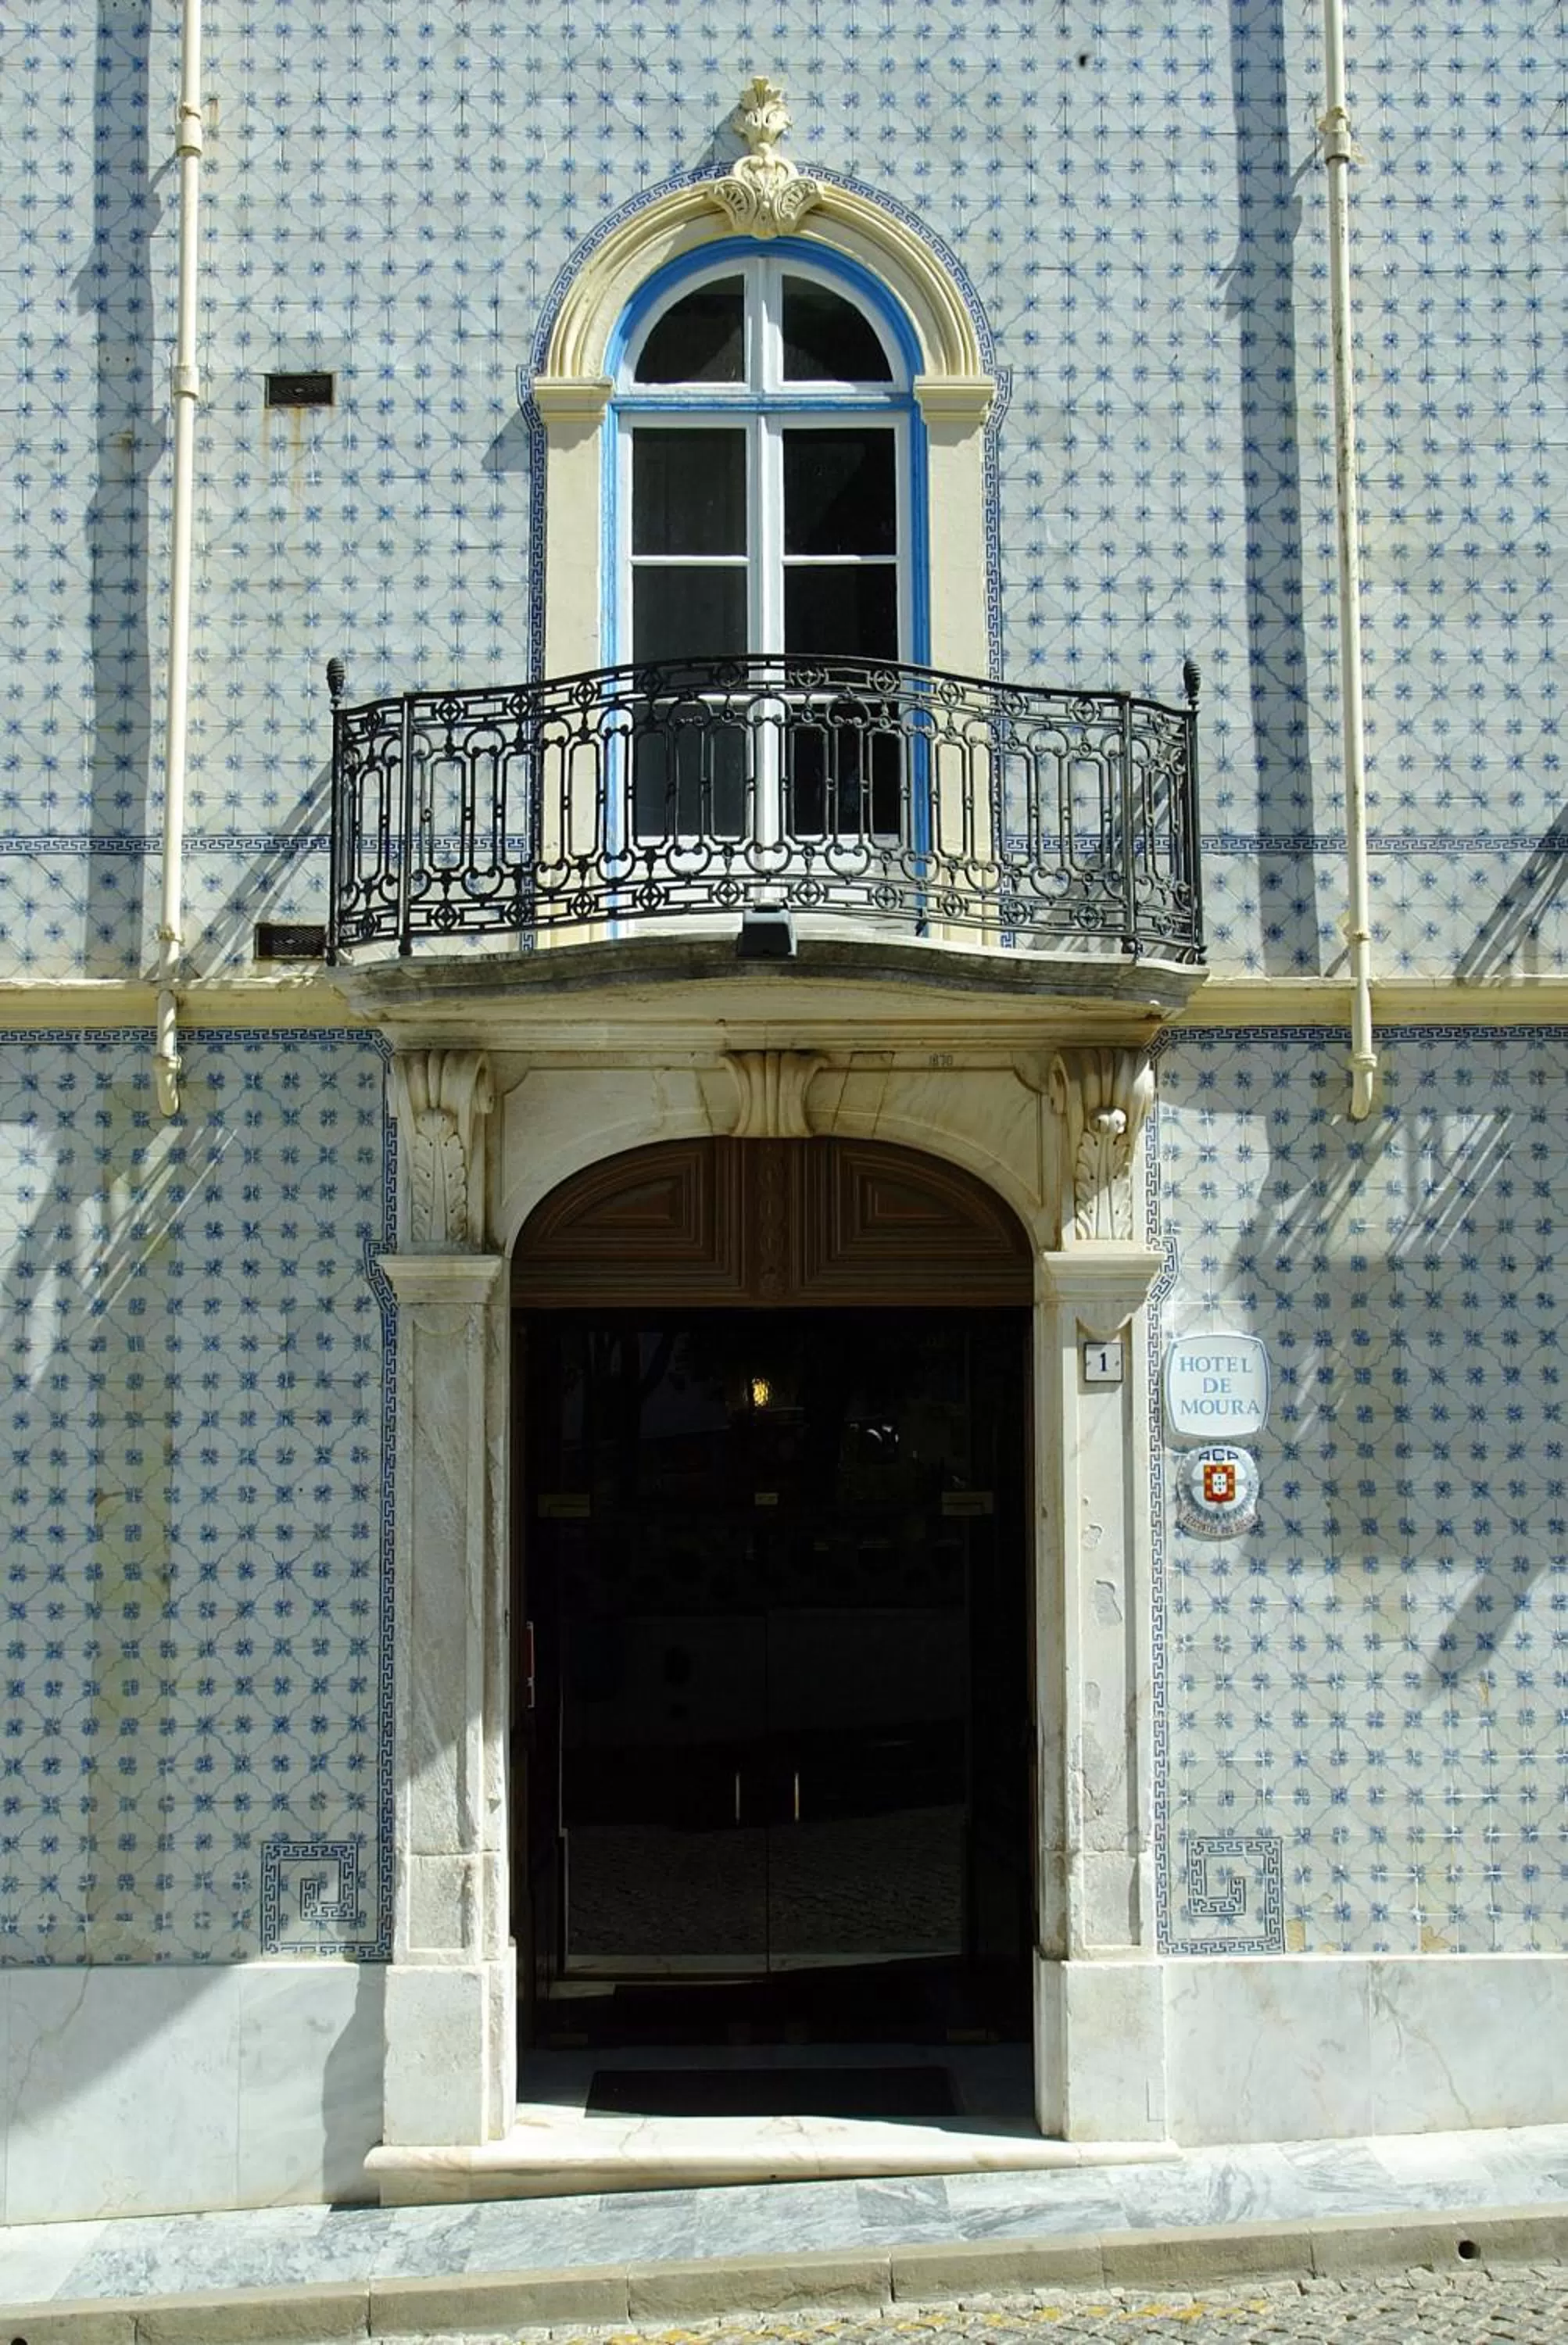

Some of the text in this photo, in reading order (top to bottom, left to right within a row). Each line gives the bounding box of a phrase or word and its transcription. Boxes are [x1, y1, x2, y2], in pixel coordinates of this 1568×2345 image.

[1099, 1352, 1108, 1372] 1
[1180, 1356, 1252, 1373] HOTEL
[1204, 1378, 1232, 1393] DE
[1181, 1399, 1261, 1415] MOURA
[1199, 1448, 1239, 1461] ACP
